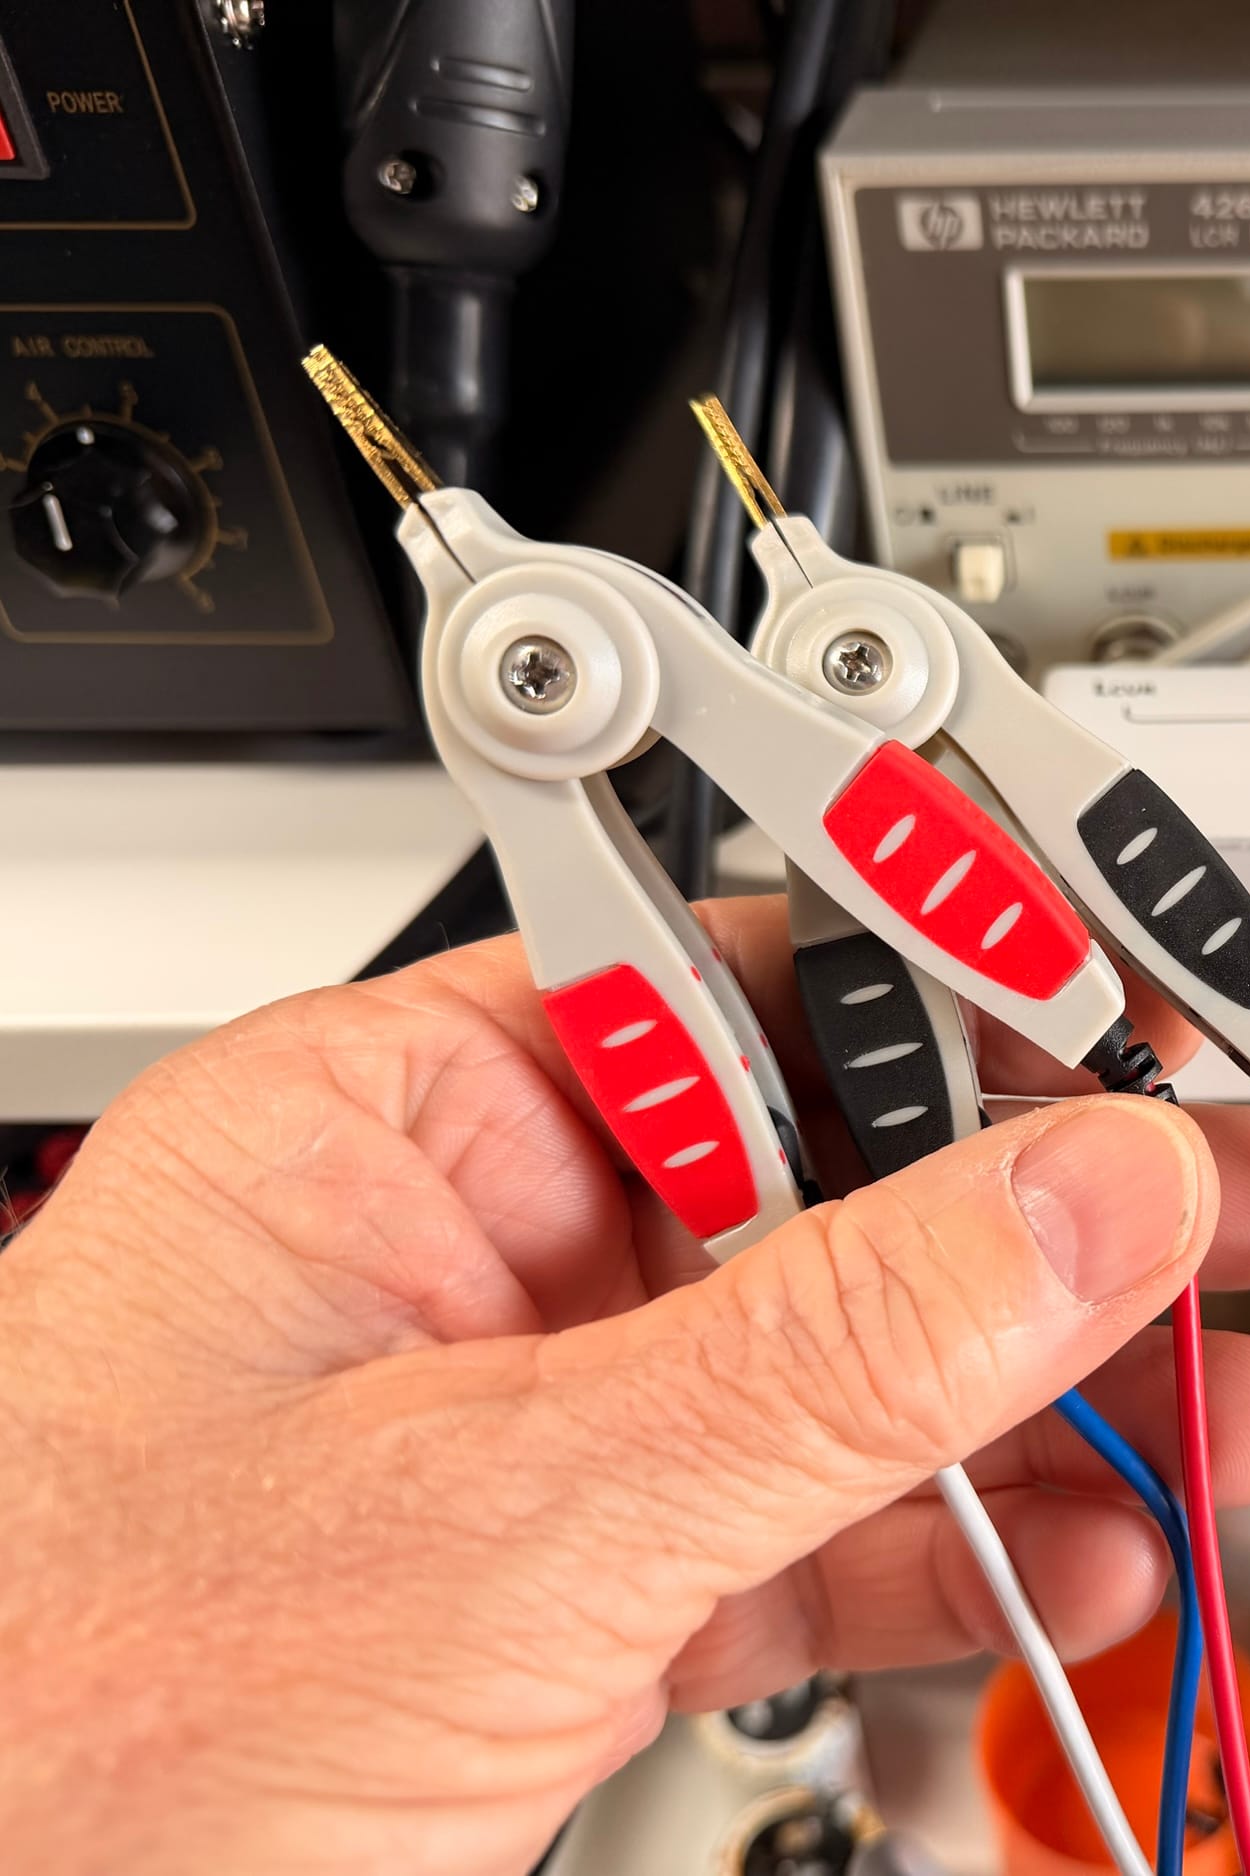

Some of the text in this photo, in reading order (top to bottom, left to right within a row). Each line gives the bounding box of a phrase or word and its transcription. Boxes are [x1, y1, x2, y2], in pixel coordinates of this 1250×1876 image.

[46, 91, 122, 114] POWER
[989, 193, 1148, 221] HEWLETT
[991, 223, 1150, 250] PACKARD
[1189, 223, 1240, 248] LCR
[12, 336, 154, 358] AIR CONTROL
